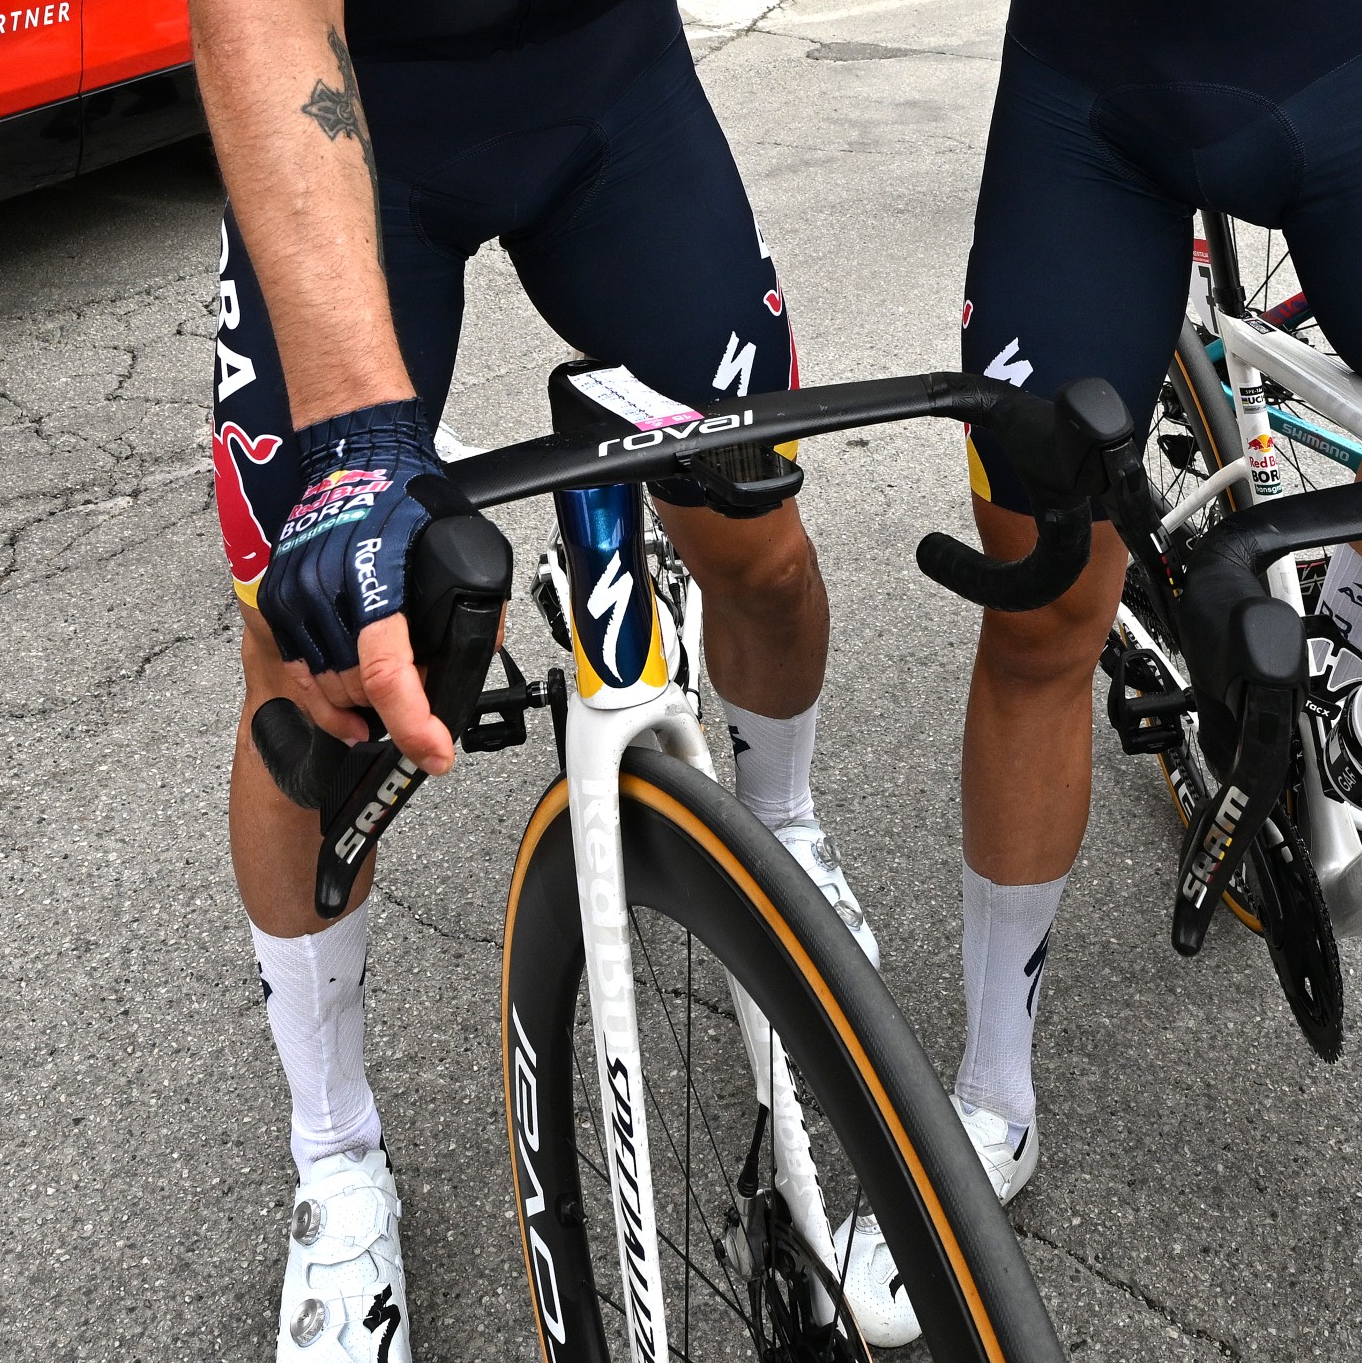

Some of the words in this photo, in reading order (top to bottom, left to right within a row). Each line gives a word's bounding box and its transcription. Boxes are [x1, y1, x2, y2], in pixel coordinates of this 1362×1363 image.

[598, 409, 754, 458] roval
[1281, 422, 1350, 463] SHIMANO
[1251, 469, 1280, 484] BOR
[279, 492, 376, 542] BORA
[288, 490, 329, 521] Red
[327, 480, 394, 503] Bull
[1182, 785, 1250, 910] SRAM
